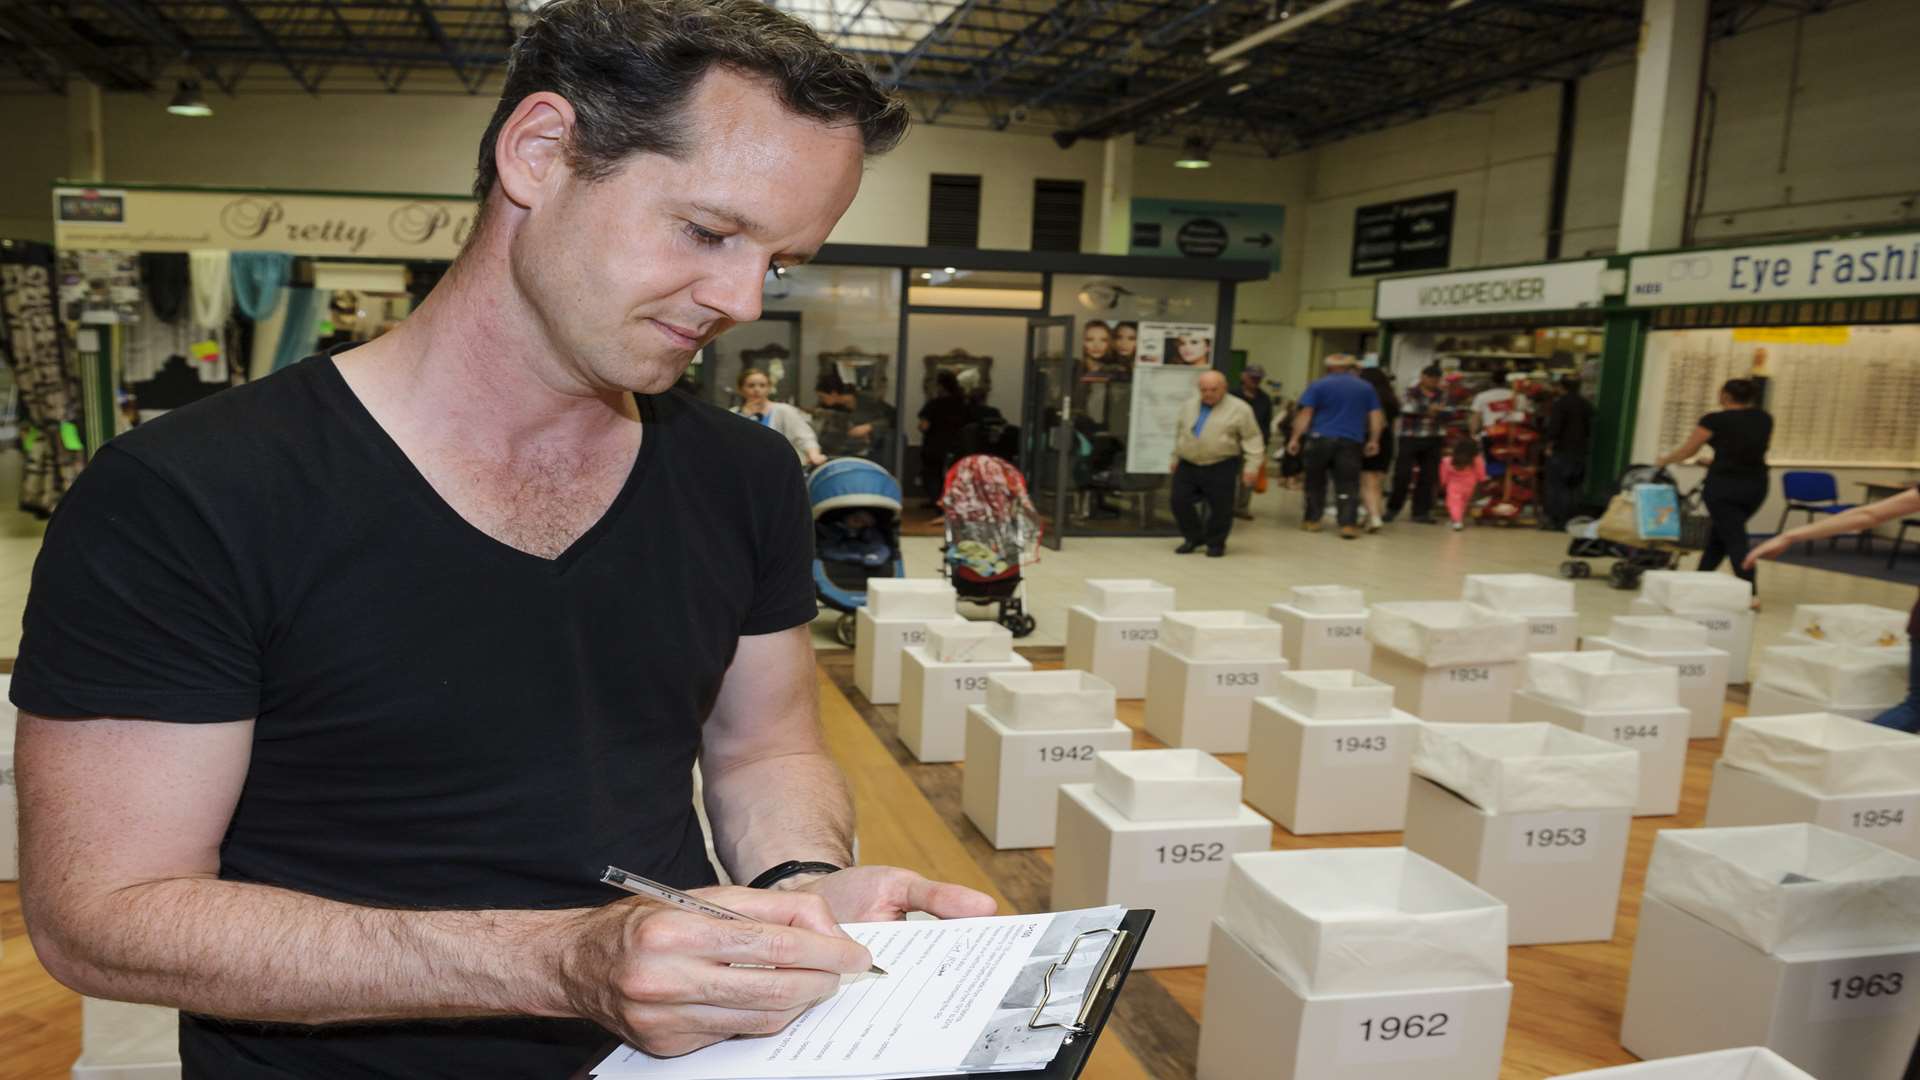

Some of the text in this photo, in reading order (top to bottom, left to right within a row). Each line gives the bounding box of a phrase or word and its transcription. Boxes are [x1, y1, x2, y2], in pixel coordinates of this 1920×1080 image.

[220, 197, 369, 251] Pretty
[1730, 242, 1920, 293] Eye Fashi
[1418, 276, 1545, 306] WOODPECKER
[1121, 628, 1159, 641] 1923
[1327, 624, 1363, 638] 1924
[1216, 672, 1259, 686] 1933
[1450, 667, 1489, 682] 1934
[1613, 724, 1659, 741] 1944
[1039, 744, 1095, 763] 1942
[1335, 735, 1388, 752] 1943
[1852, 808, 1905, 829] 1954
[1525, 827, 1587, 848] 1953
[1156, 842, 1225, 864] 1952
[1829, 971, 1905, 1001] 1963
[1360, 1011, 1449, 1042] 1962
